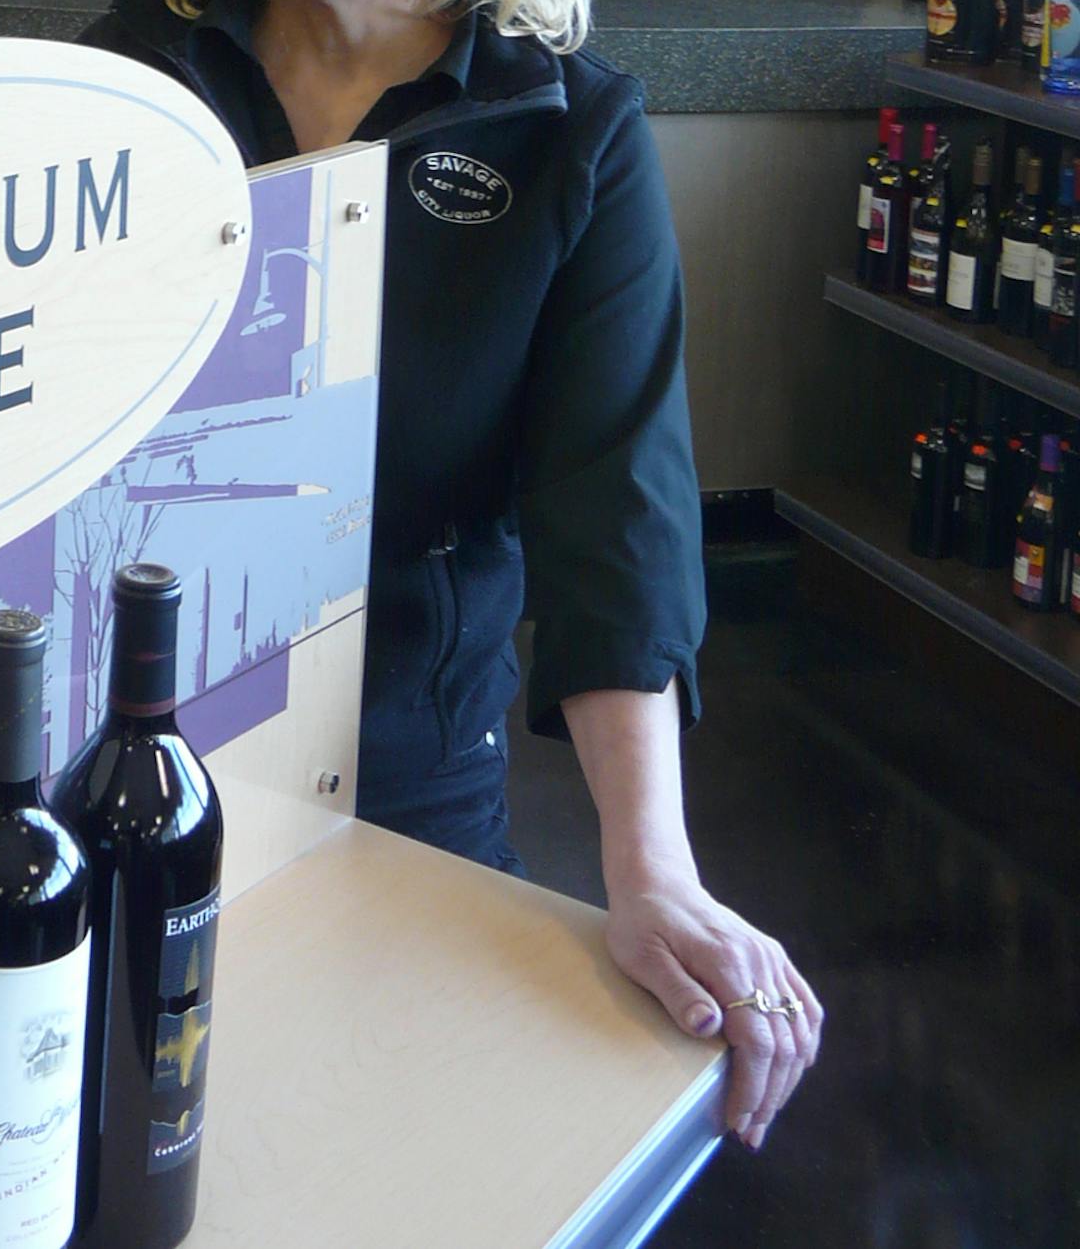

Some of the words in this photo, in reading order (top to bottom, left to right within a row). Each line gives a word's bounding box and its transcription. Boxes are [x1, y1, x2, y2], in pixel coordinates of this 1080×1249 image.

[426, 156, 502, 191] SAVAGE
[418, 189, 441, 211] CITY
[442, 209, 492, 221] LIQUOR
